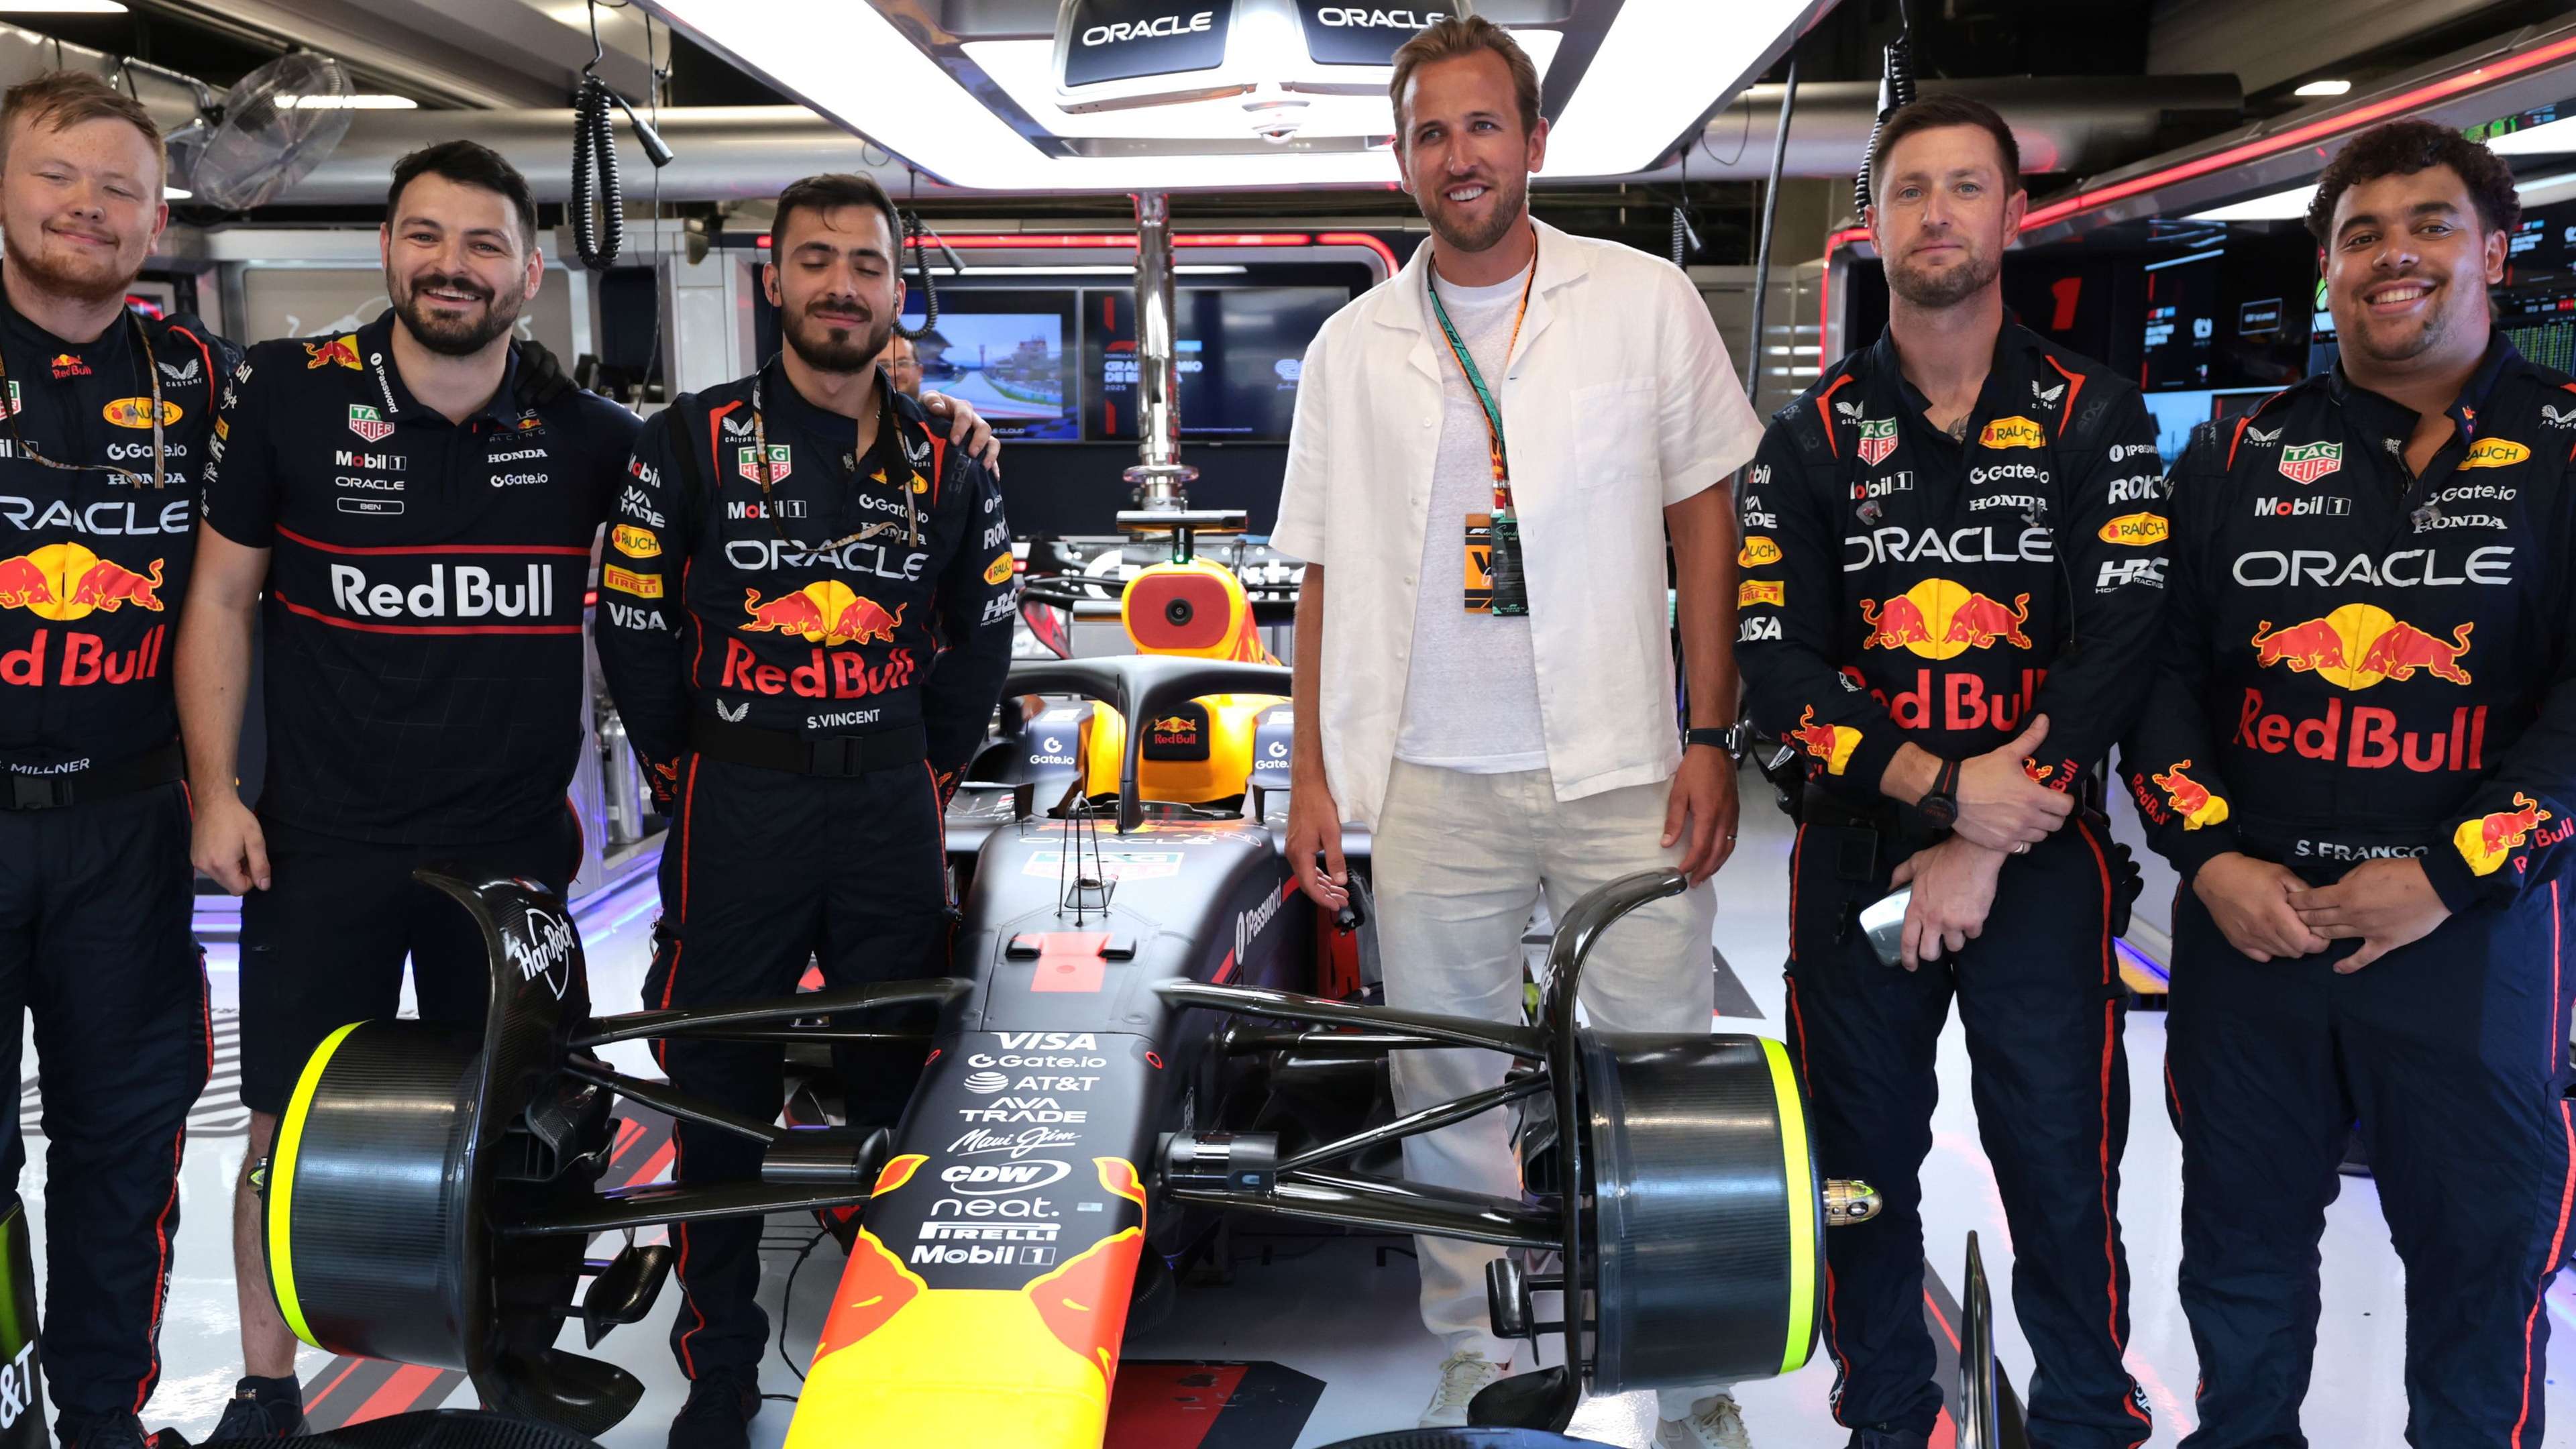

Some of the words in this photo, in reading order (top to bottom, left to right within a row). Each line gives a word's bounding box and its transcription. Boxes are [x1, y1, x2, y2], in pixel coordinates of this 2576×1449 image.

[1083, 11, 1212, 46] ORACLE
[52, 368, 70, 380] Red
[71, 364, 92, 376] Bull
[166, 377, 202, 387] CASTORE
[376, 366, 398, 413] 1Password
[354, 407, 381, 420] TA
[353, 421, 393, 441] HEUER
[1996, 426, 2043, 441] RAUCH
[126, 443, 187, 458] Gae.io
[488, 449, 547, 463] HONDA
[2289, 445, 2337, 460] TAG
[336, 451, 386, 470] Mobil
[392, 457, 402, 469] 1
[504, 473, 548, 485] Gate.io
[743, 464, 790, 479] HEER
[2283, 460, 2337, 481] HEUER
[335, 476, 405, 490] ORACLE
[1897, 474, 1907, 488] 1
[2442, 484, 2516, 502] Gate.io
[0, 496, 189, 535] RACLE
[792, 502, 800, 516] 1
[2255, 496, 2324, 517] Mobil
[2334, 500, 2343, 514] 1
[2122, 522, 2167, 536] RAUCH
[621, 533, 658, 551] RAUCH
[724, 539, 929, 582] ORACLE
[2233, 547, 2516, 587] ORACLE
[2095, 557, 2169, 587] HRC
[331, 564, 444, 617] Red
[455, 564, 552, 617] Bull
[608, 570, 657, 594] PIRELLI
[2133, 578, 2163, 589] RACING
[606, 601, 667, 631] VISA
[60, 625, 165, 686] Bull
[721, 637, 827, 698] Red
[830, 648, 914, 698] Bull
[807, 709, 880, 729] S.VINCENT
[1155, 733, 1173, 744] Red
[1175, 733, 1195, 744] Bull
[2233, 688, 2343, 761] Red
[2348, 705, 2487, 772] Bull
[10, 758, 90, 775] MILLNER
[1030, 755, 1075, 765] Gate.io
[1255, 759, 1289, 769] Gate.
[2050, 759, 2079, 793] Bull
[2133, 773, 2153, 806] Red
[2534, 817, 2575, 847] Bull
[1246, 877, 1281, 945] 1Password
[990, 1032, 1097, 1050] VISA
[999, 1055, 1106, 1068] Gate.io
[1014, 1077, 1100, 1091] AT&T
[989, 1097, 1060, 1109] AVA
[959, 1110, 1087, 1123] TRADE
[947, 1128, 1014, 1152] Maui
[1010, 1126, 1082, 1159] Jim
[941, 1166, 1042, 1182] CDW
[931, 1197, 1059, 1218] neat.
[919, 1222, 1061, 1240] PIRELLI
[910, 1245, 1014, 1264] Mobil
[1032, 1248, 1044, 1263] 1
